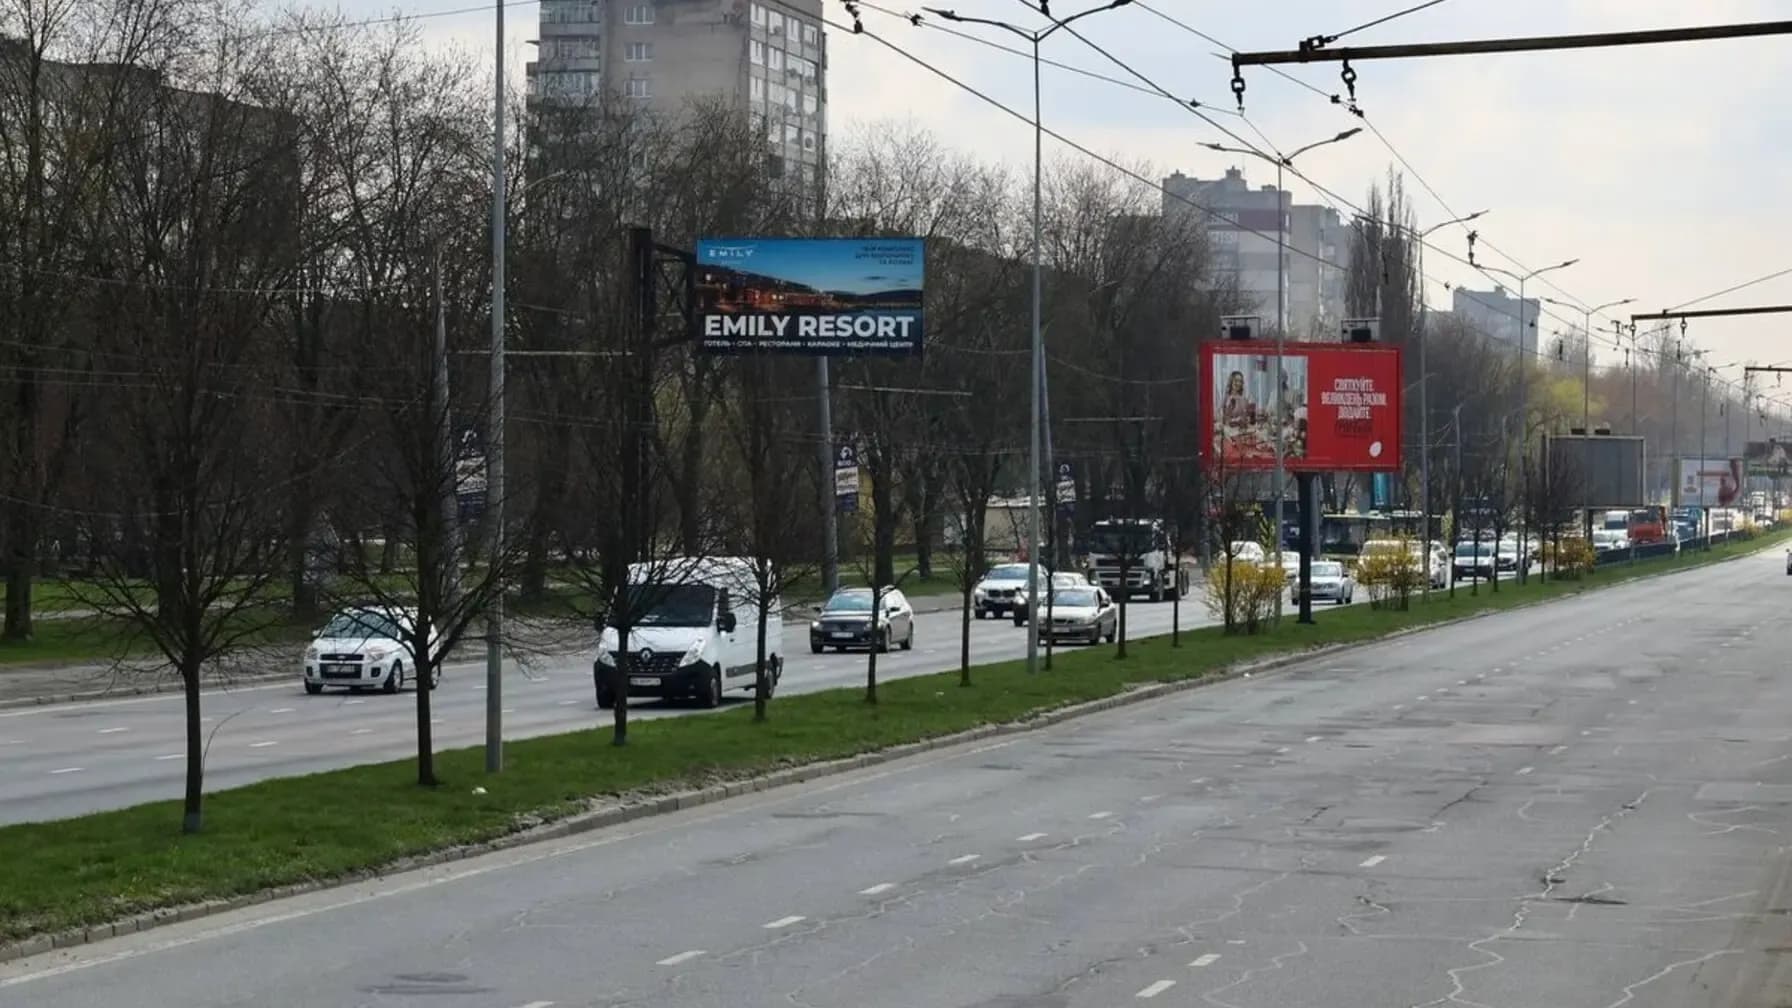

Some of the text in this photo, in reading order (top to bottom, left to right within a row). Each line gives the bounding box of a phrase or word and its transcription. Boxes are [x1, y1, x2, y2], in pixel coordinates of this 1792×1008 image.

[709, 249, 753, 257] EMILY
[705, 316, 914, 337] EMILY RESORT
[703, 340, 732, 348] ГОТЕЛЬ
[807, 340, 840, 348] КАРАОКЕ
